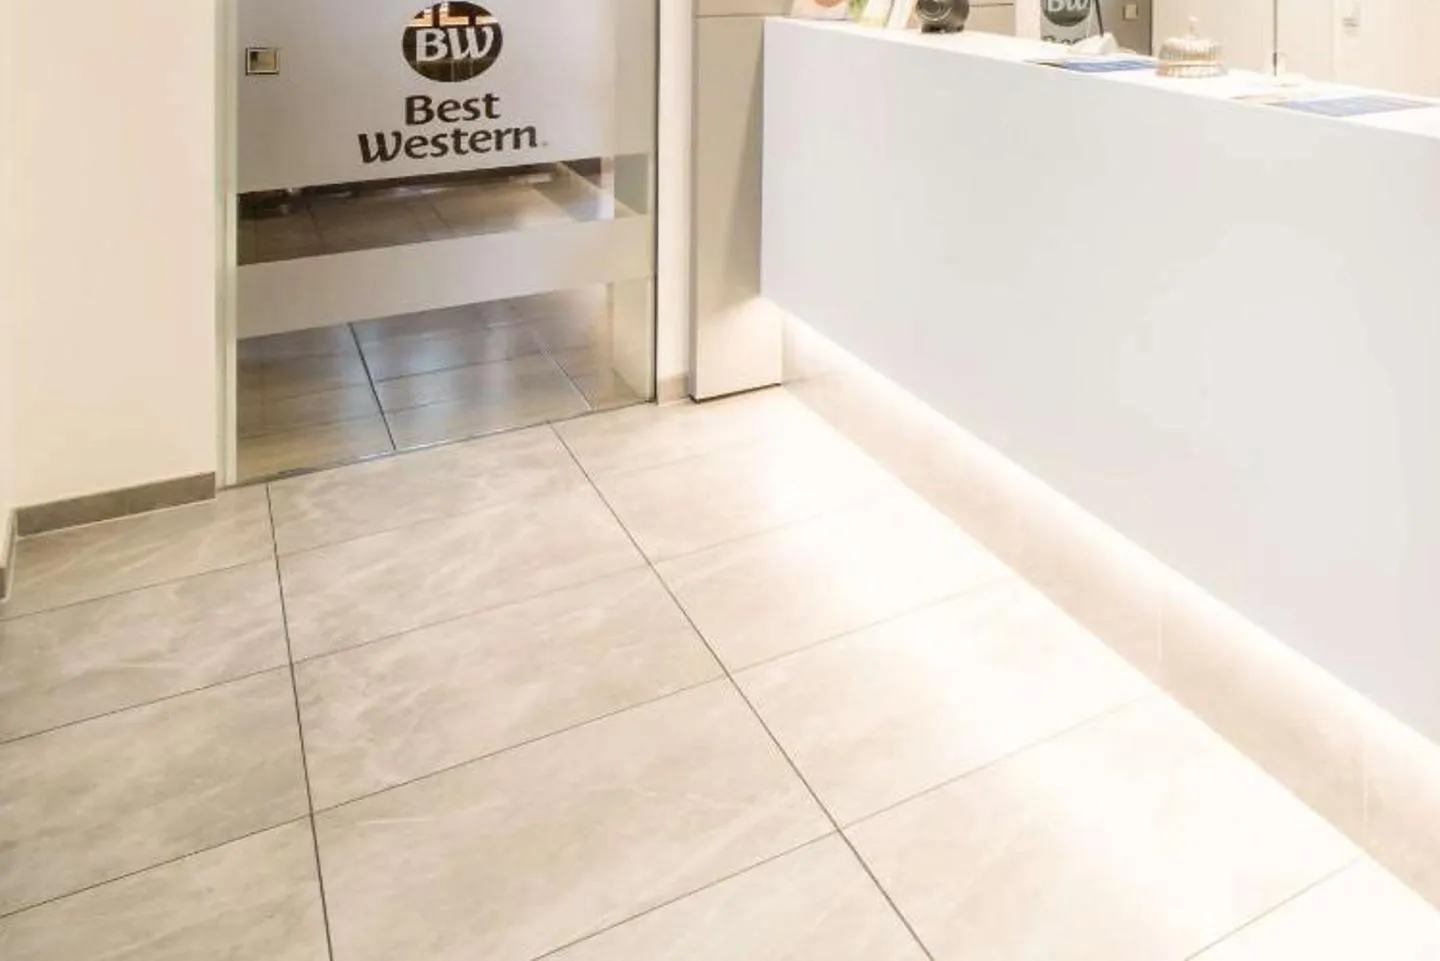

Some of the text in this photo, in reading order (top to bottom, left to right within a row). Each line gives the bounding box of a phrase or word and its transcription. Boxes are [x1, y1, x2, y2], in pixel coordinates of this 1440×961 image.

[415, 25, 495, 63] BW
[404, 93, 501, 126] Best
[357, 124, 538, 165] Western
